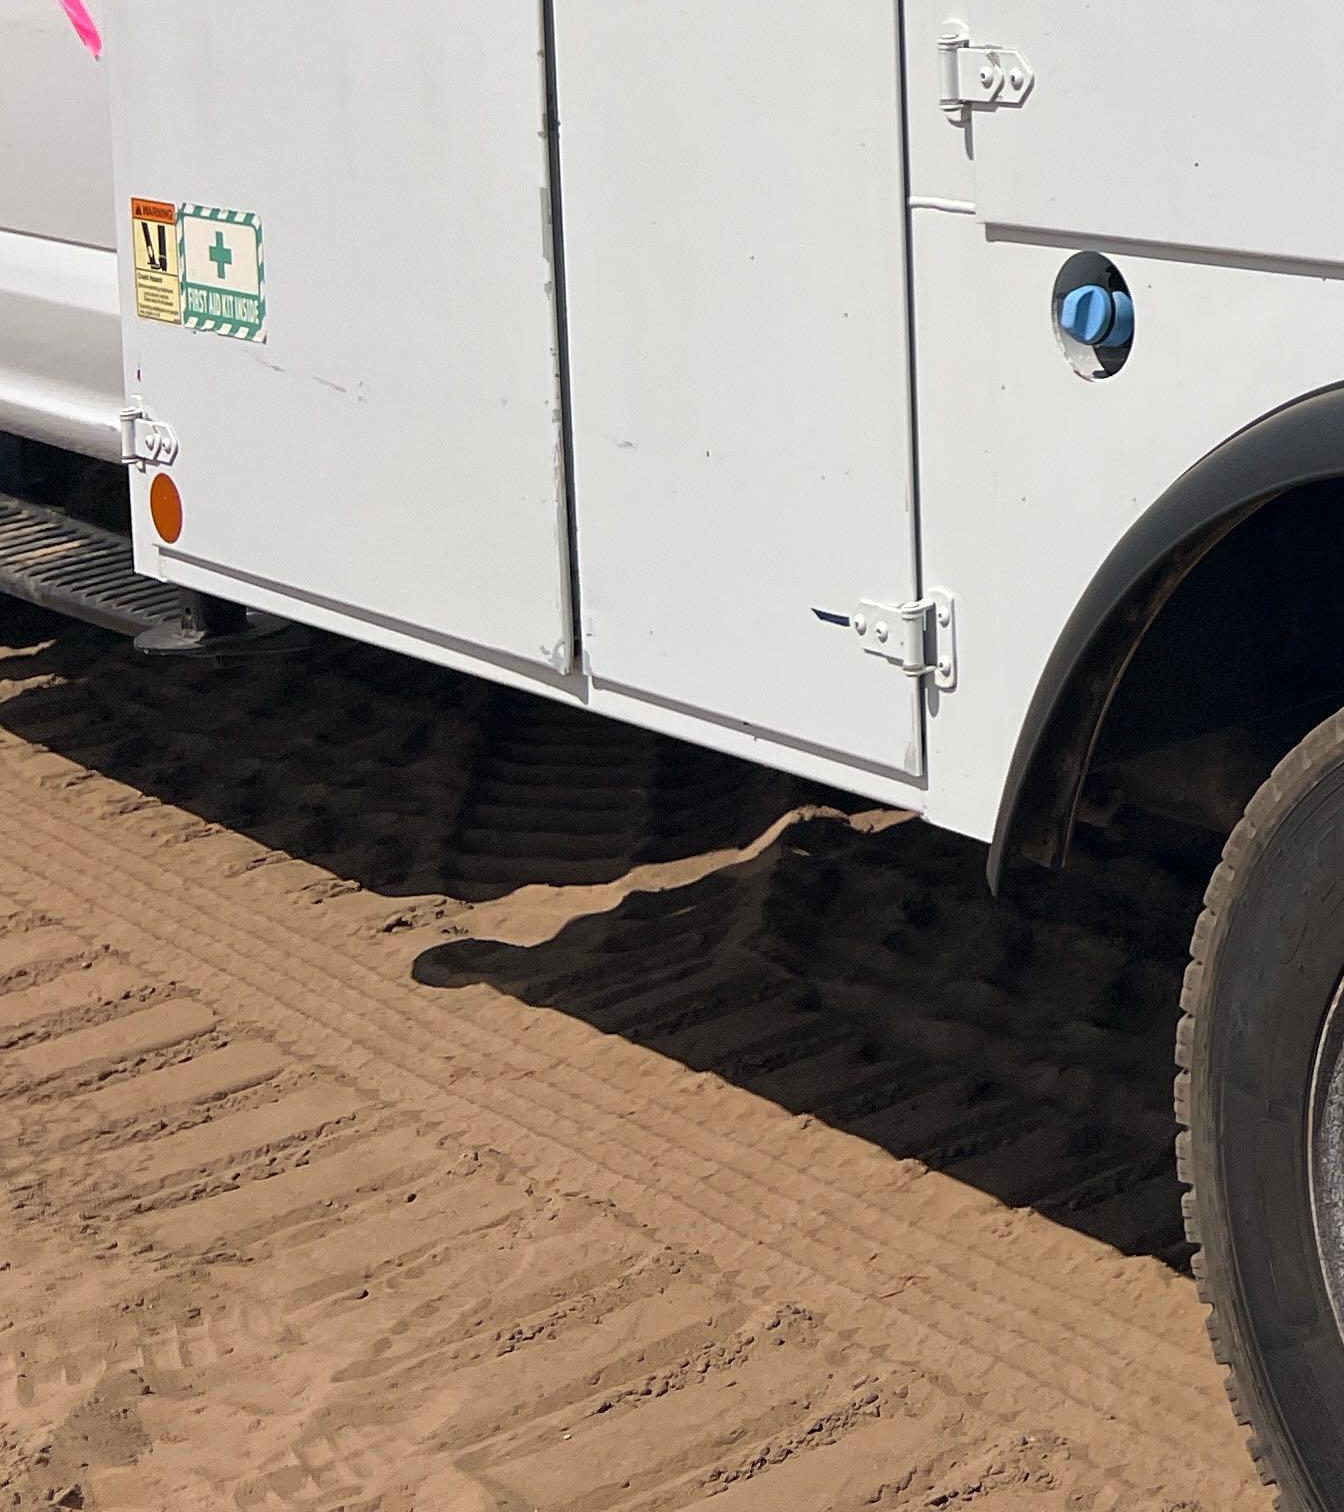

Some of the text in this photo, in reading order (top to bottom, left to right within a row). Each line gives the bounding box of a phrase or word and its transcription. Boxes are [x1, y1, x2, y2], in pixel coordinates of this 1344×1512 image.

[142, 206, 173, 220] WARNING
[187, 287, 208, 314] FIRST
[208, 291, 221, 316] AID
[221, 294, 234, 319] KIT
[234, 296, 260, 325] INSIDE
